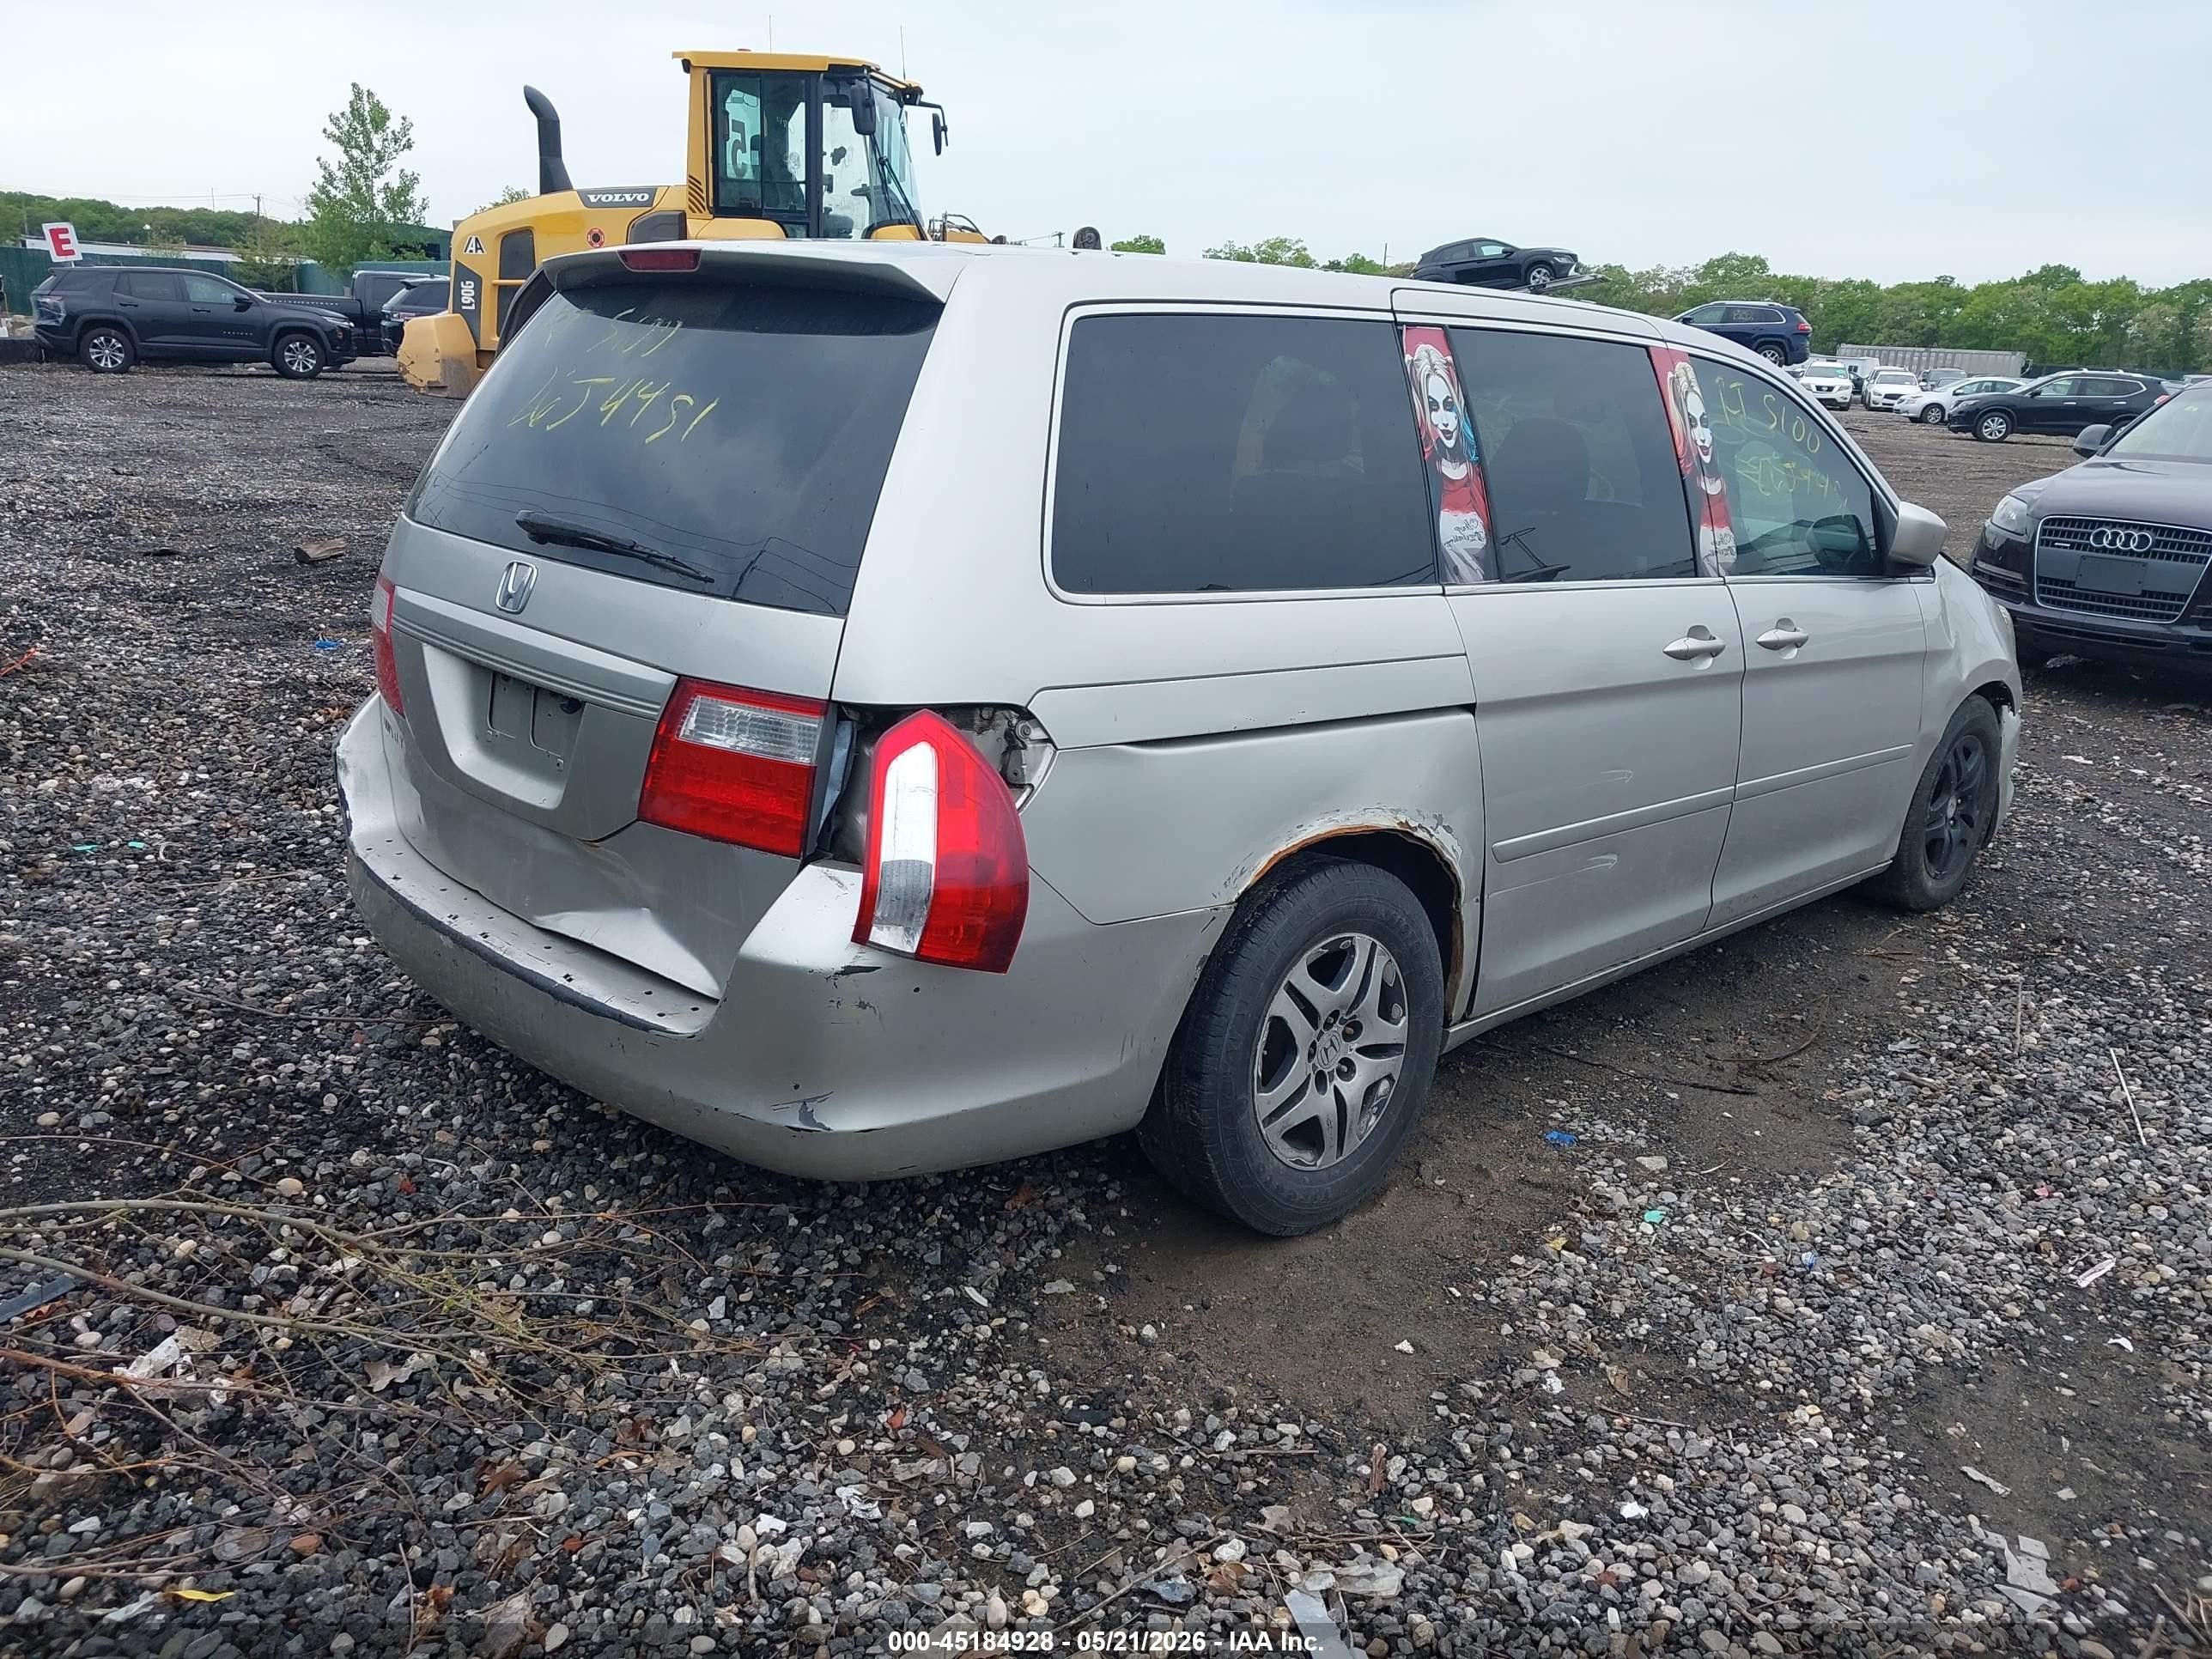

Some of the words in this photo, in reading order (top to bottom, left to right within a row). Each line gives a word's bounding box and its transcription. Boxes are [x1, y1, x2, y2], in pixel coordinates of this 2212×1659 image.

[587, 192, 649, 203] VOLVO
[49, 228, 76, 257] E
[459, 280, 476, 310] L90G
